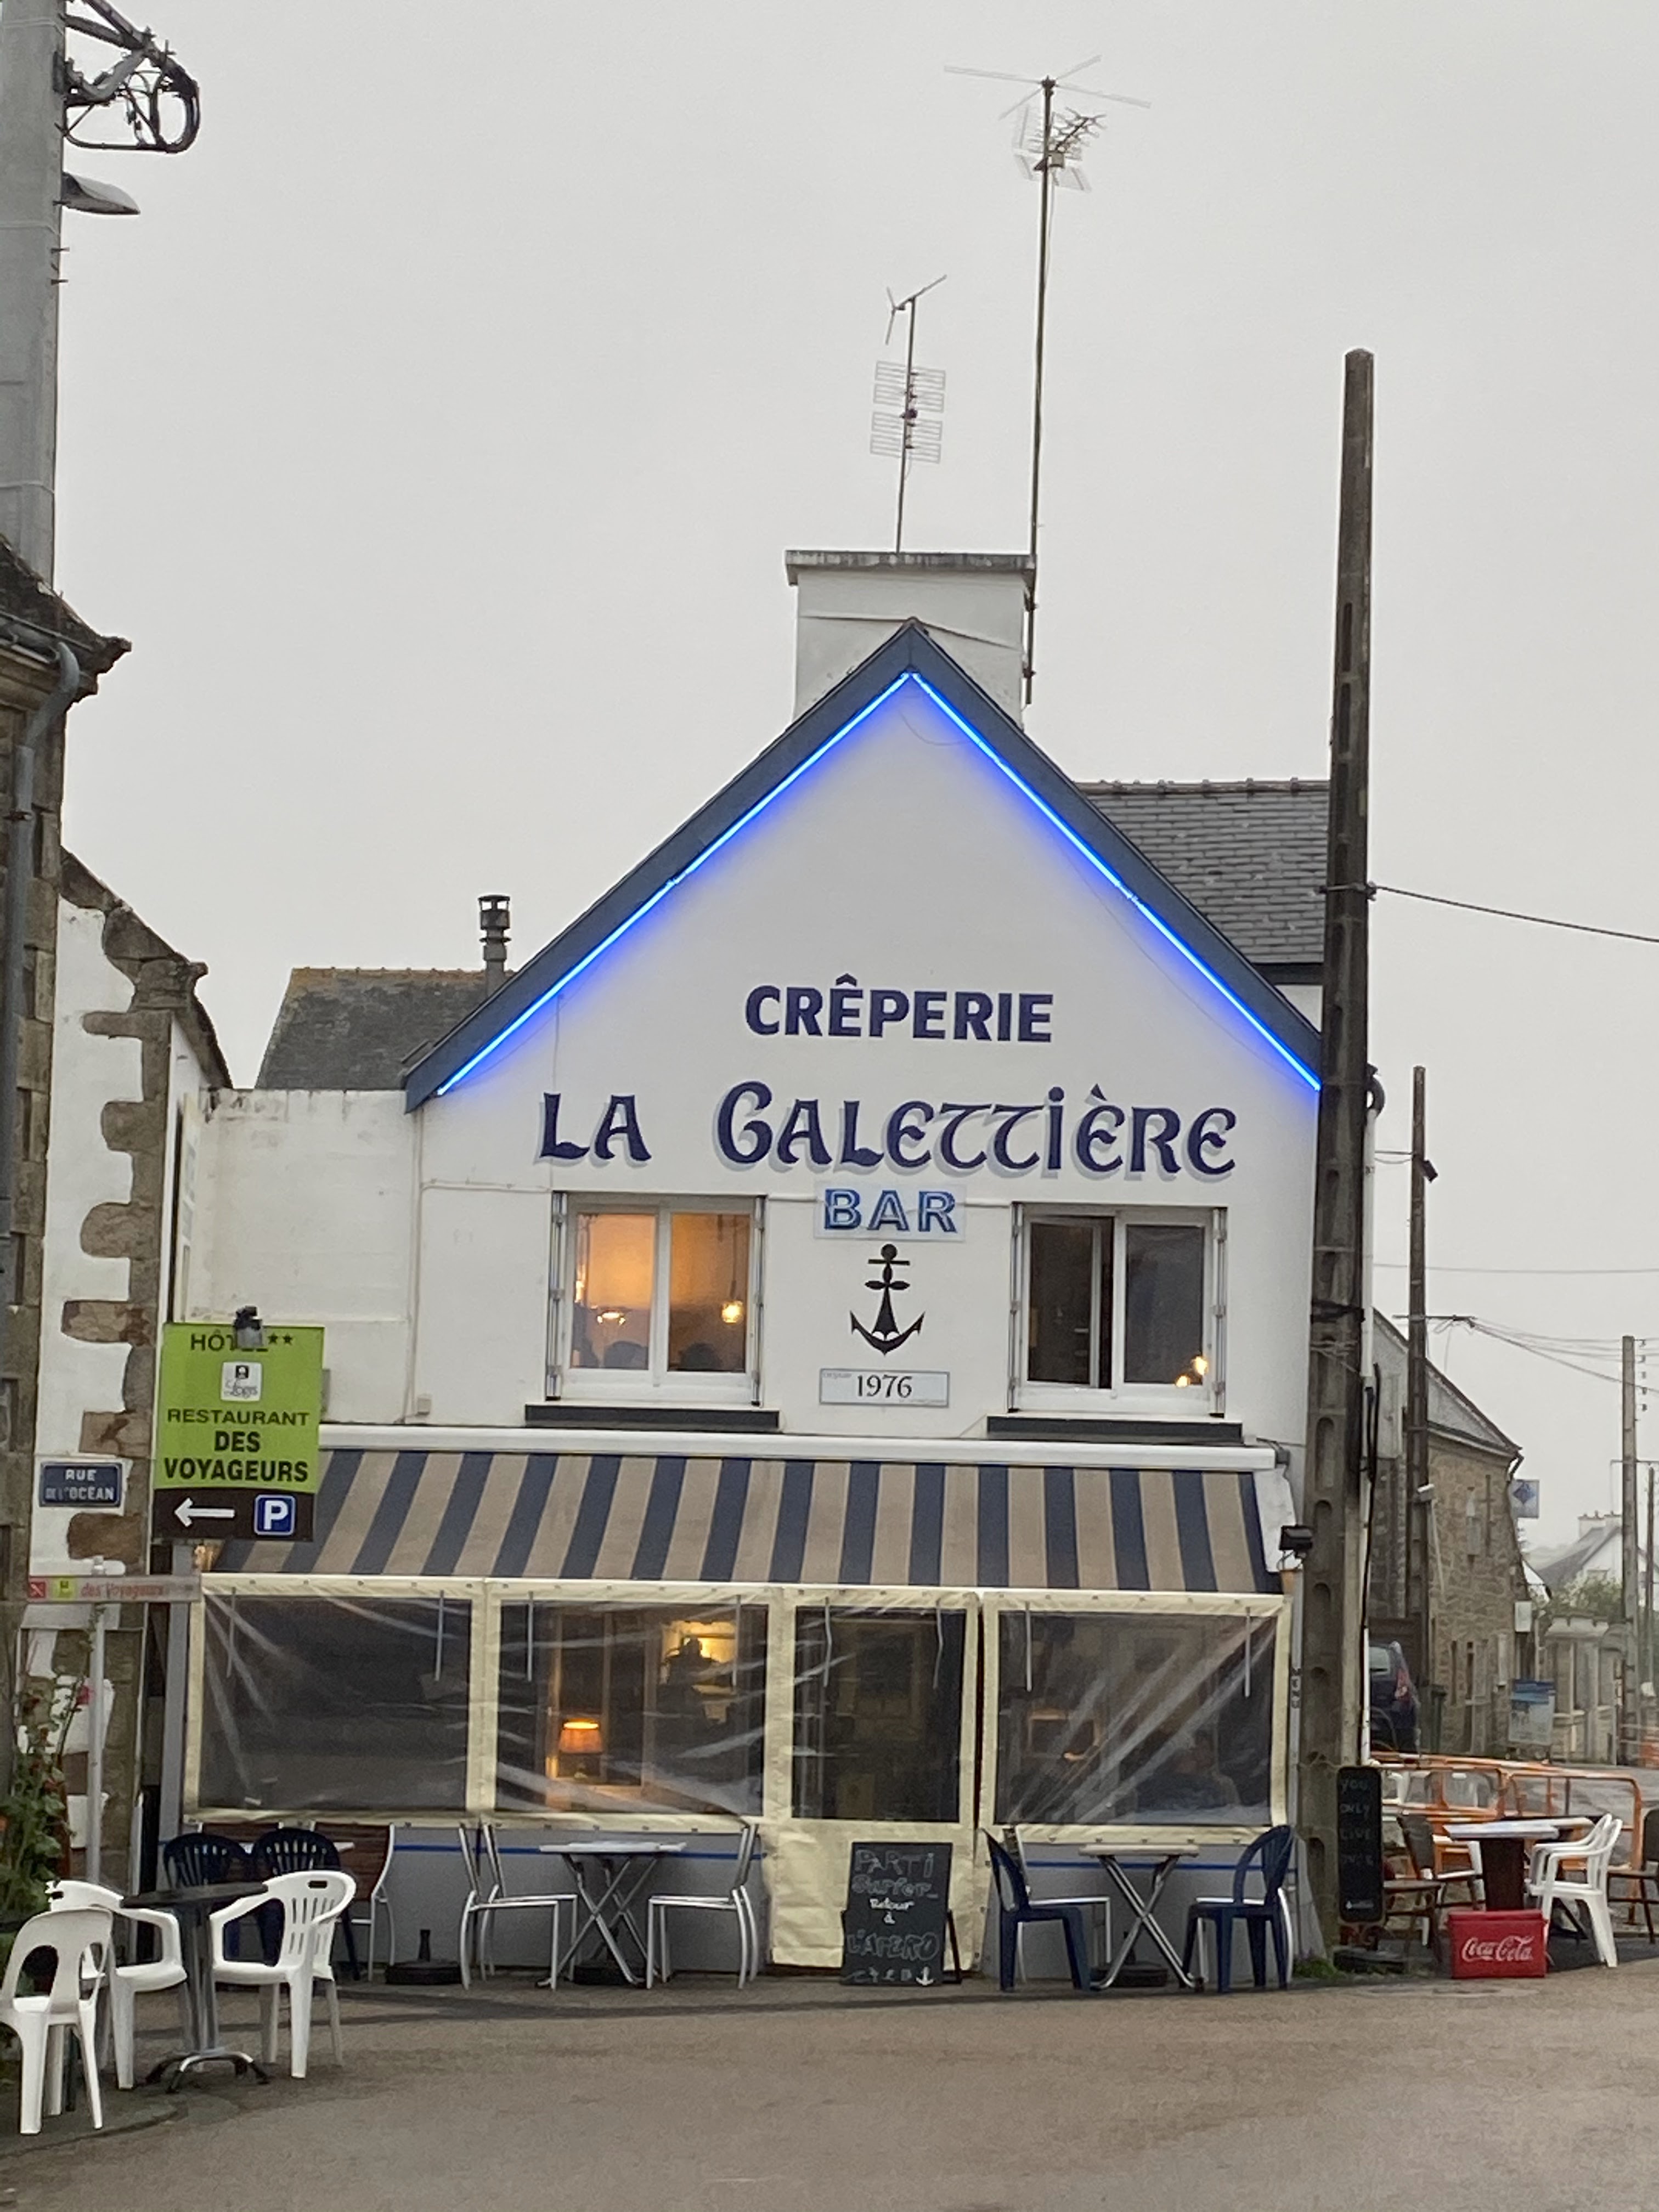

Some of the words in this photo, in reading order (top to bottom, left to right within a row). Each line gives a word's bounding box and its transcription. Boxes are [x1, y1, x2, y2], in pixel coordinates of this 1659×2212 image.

[744, 973, 1054, 1043] CRÊPERIE
[539, 1092, 652, 1162] LA
[823, 1188, 957, 1233] BAR
[190, 1328, 268, 1352] HÔT
[857, 1374, 912, 1398] 1976
[167, 1408, 310, 1426] RESTAURANT
[213, 1430, 261, 1453] DES
[65, 1468, 97, 1482] RUE
[164, 1457, 309, 1482] VOYAGEURS
[264, 1499, 289, 1531] P
